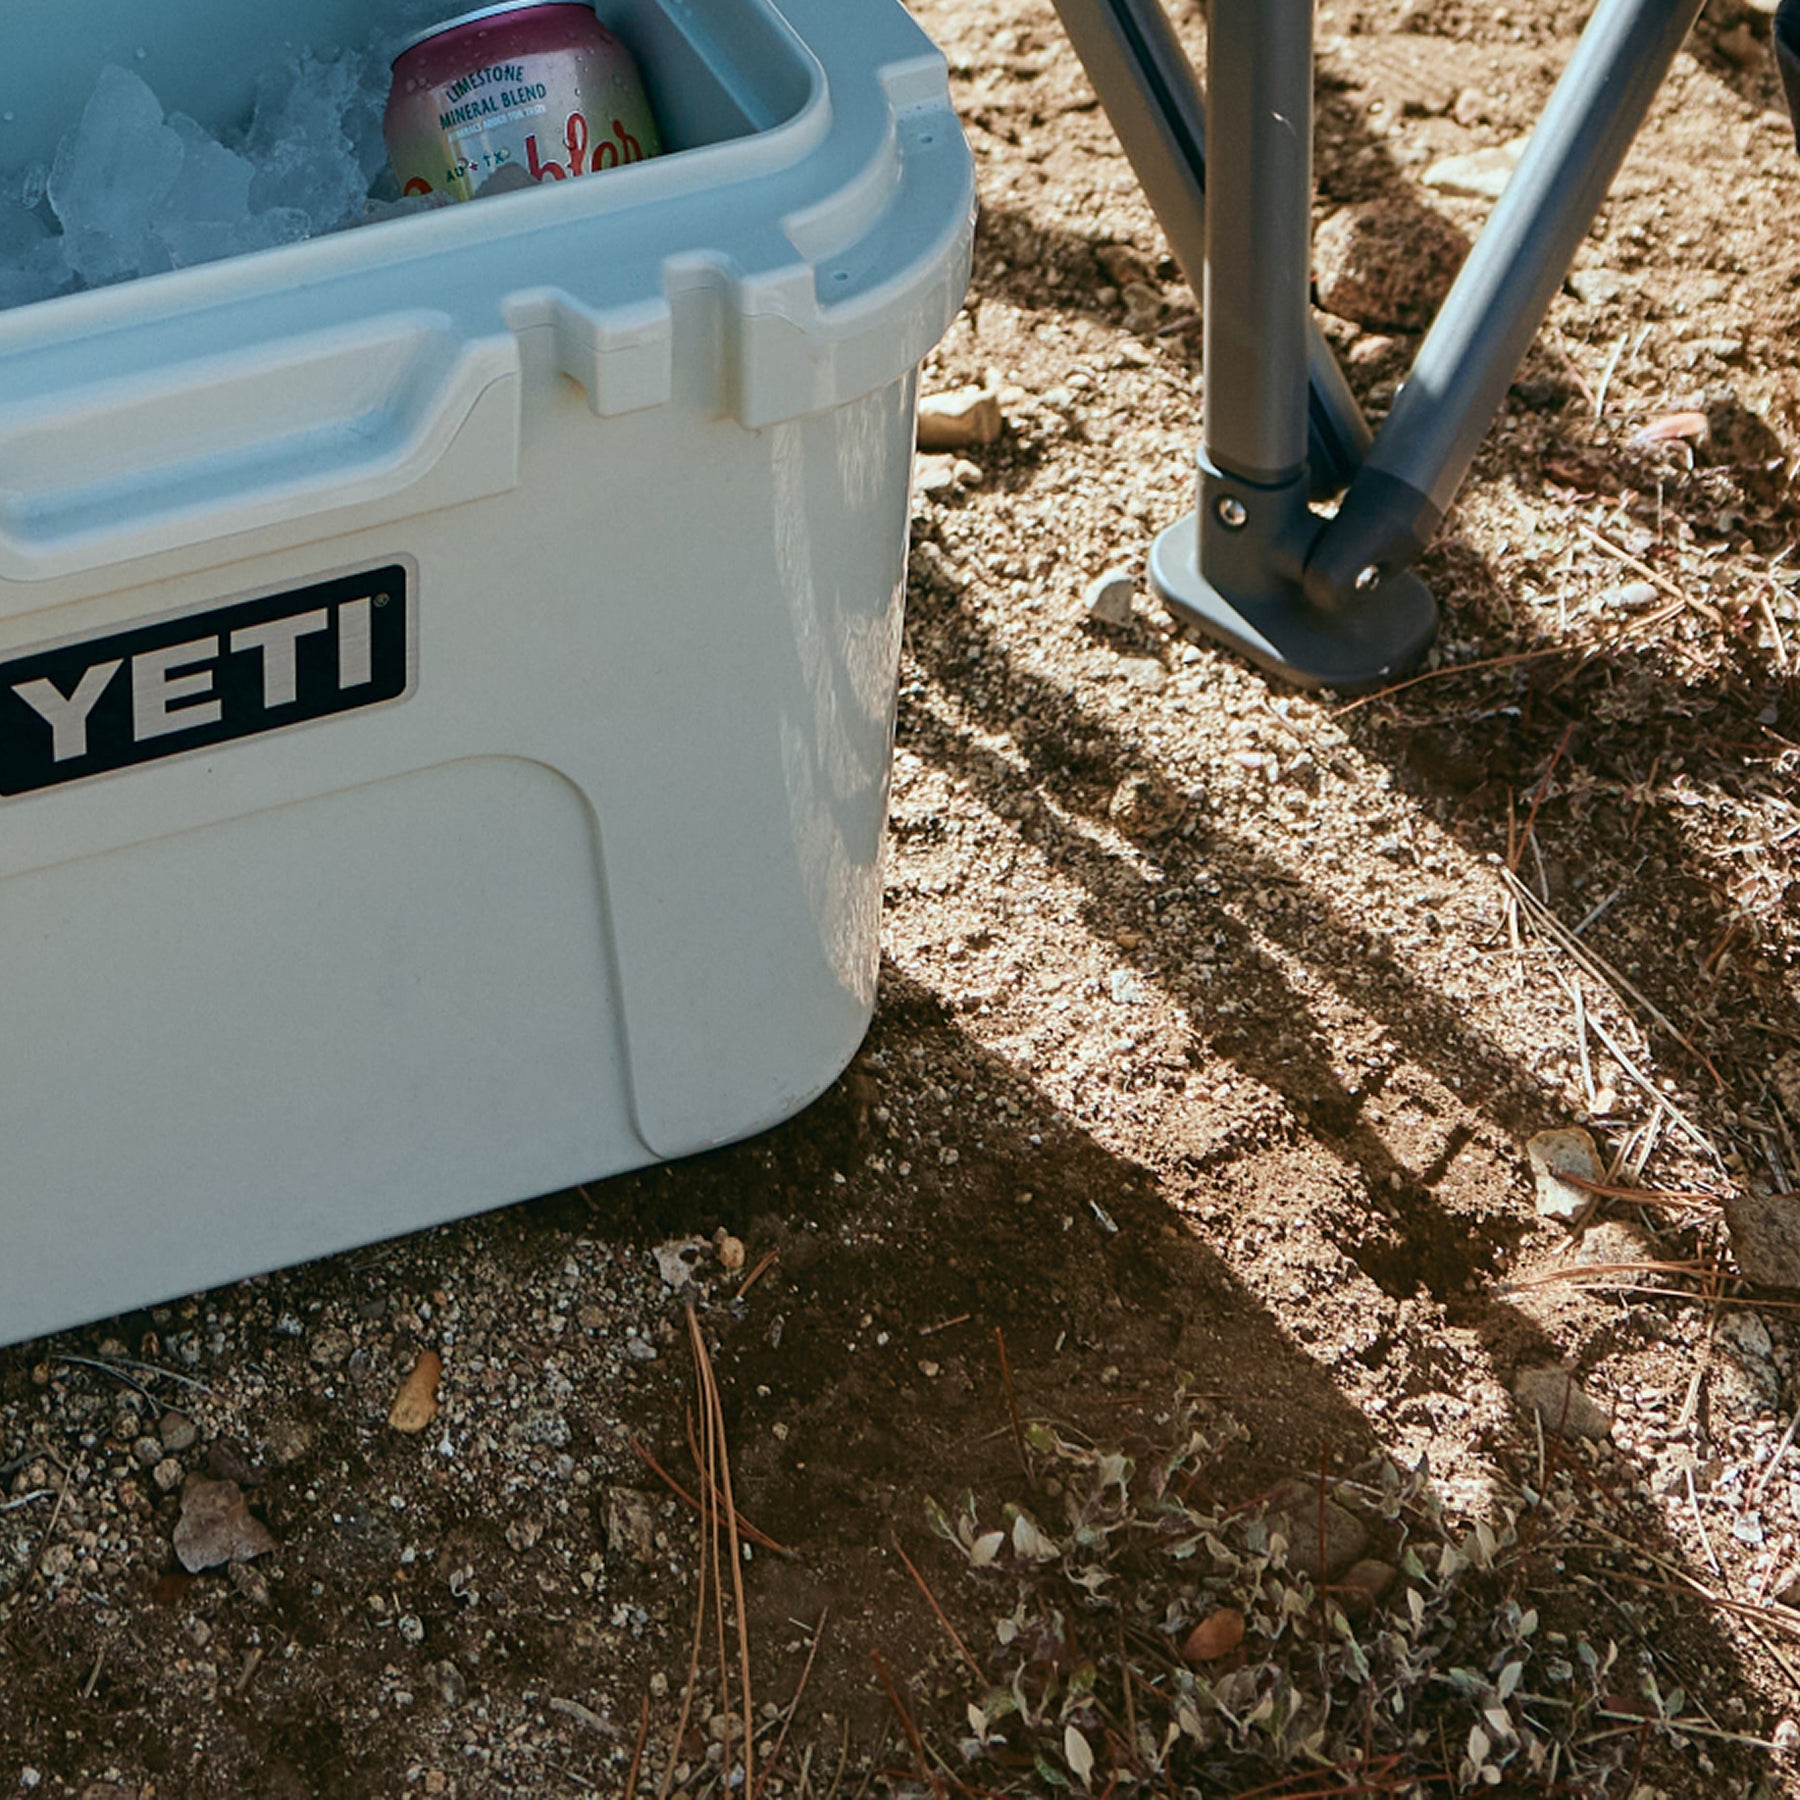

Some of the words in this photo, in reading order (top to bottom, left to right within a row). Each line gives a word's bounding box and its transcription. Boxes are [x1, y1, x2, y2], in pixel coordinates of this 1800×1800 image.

[446, 65, 525, 103] LIMESTONE
[439, 96, 499, 130] MINERAL
[501, 83, 547, 108] BLEND
[483, 151, 505, 167] TX
[10, 596, 372, 763] YETI
